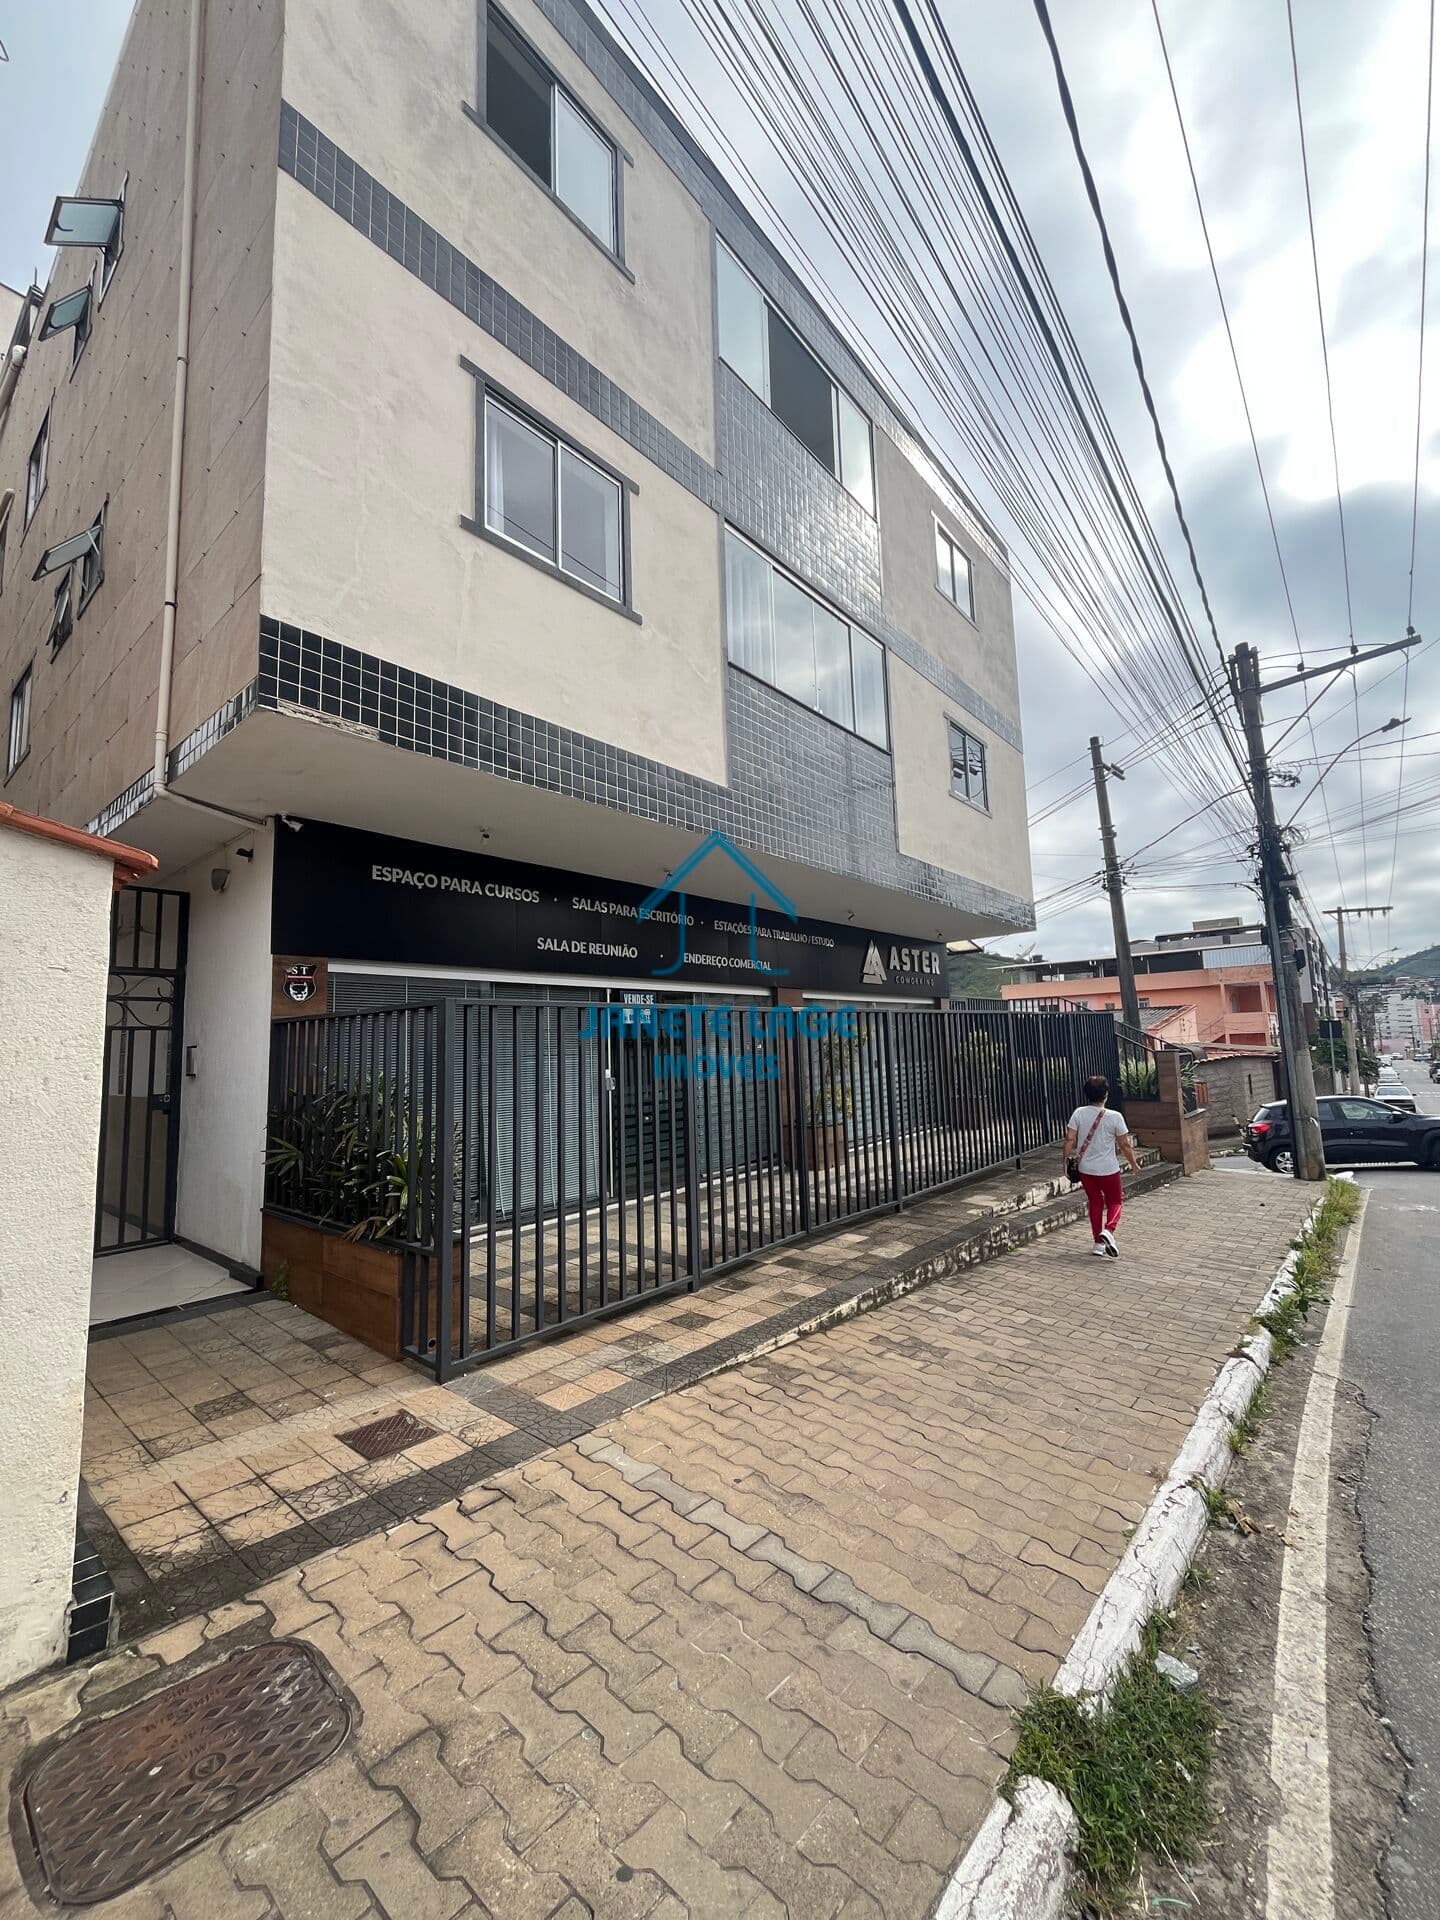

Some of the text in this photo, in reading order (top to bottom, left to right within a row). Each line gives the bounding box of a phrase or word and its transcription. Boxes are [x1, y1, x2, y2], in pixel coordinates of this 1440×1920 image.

[371, 865, 540, 903] ESPAÇO PARA CURSOS
[572, 897, 694, 926] SALAS PARA ESCRITÓRIO
[714, 920, 752, 934] ESTAÇÕES
[753, 927, 772, 938] PARA
[772, 929, 808, 943] TRABALHO
[811, 935, 835, 948] ESTUDO
[537, 937, 638, 958] SALA DE REUNIÃO
[683, 952, 772, 971] ENDEREÇO COMERCIAL
[889, 946, 941, 975] ASTER
[895, 975, 935, 986] COWORKING
[623, 993, 654, 1004] VENDE-SE
